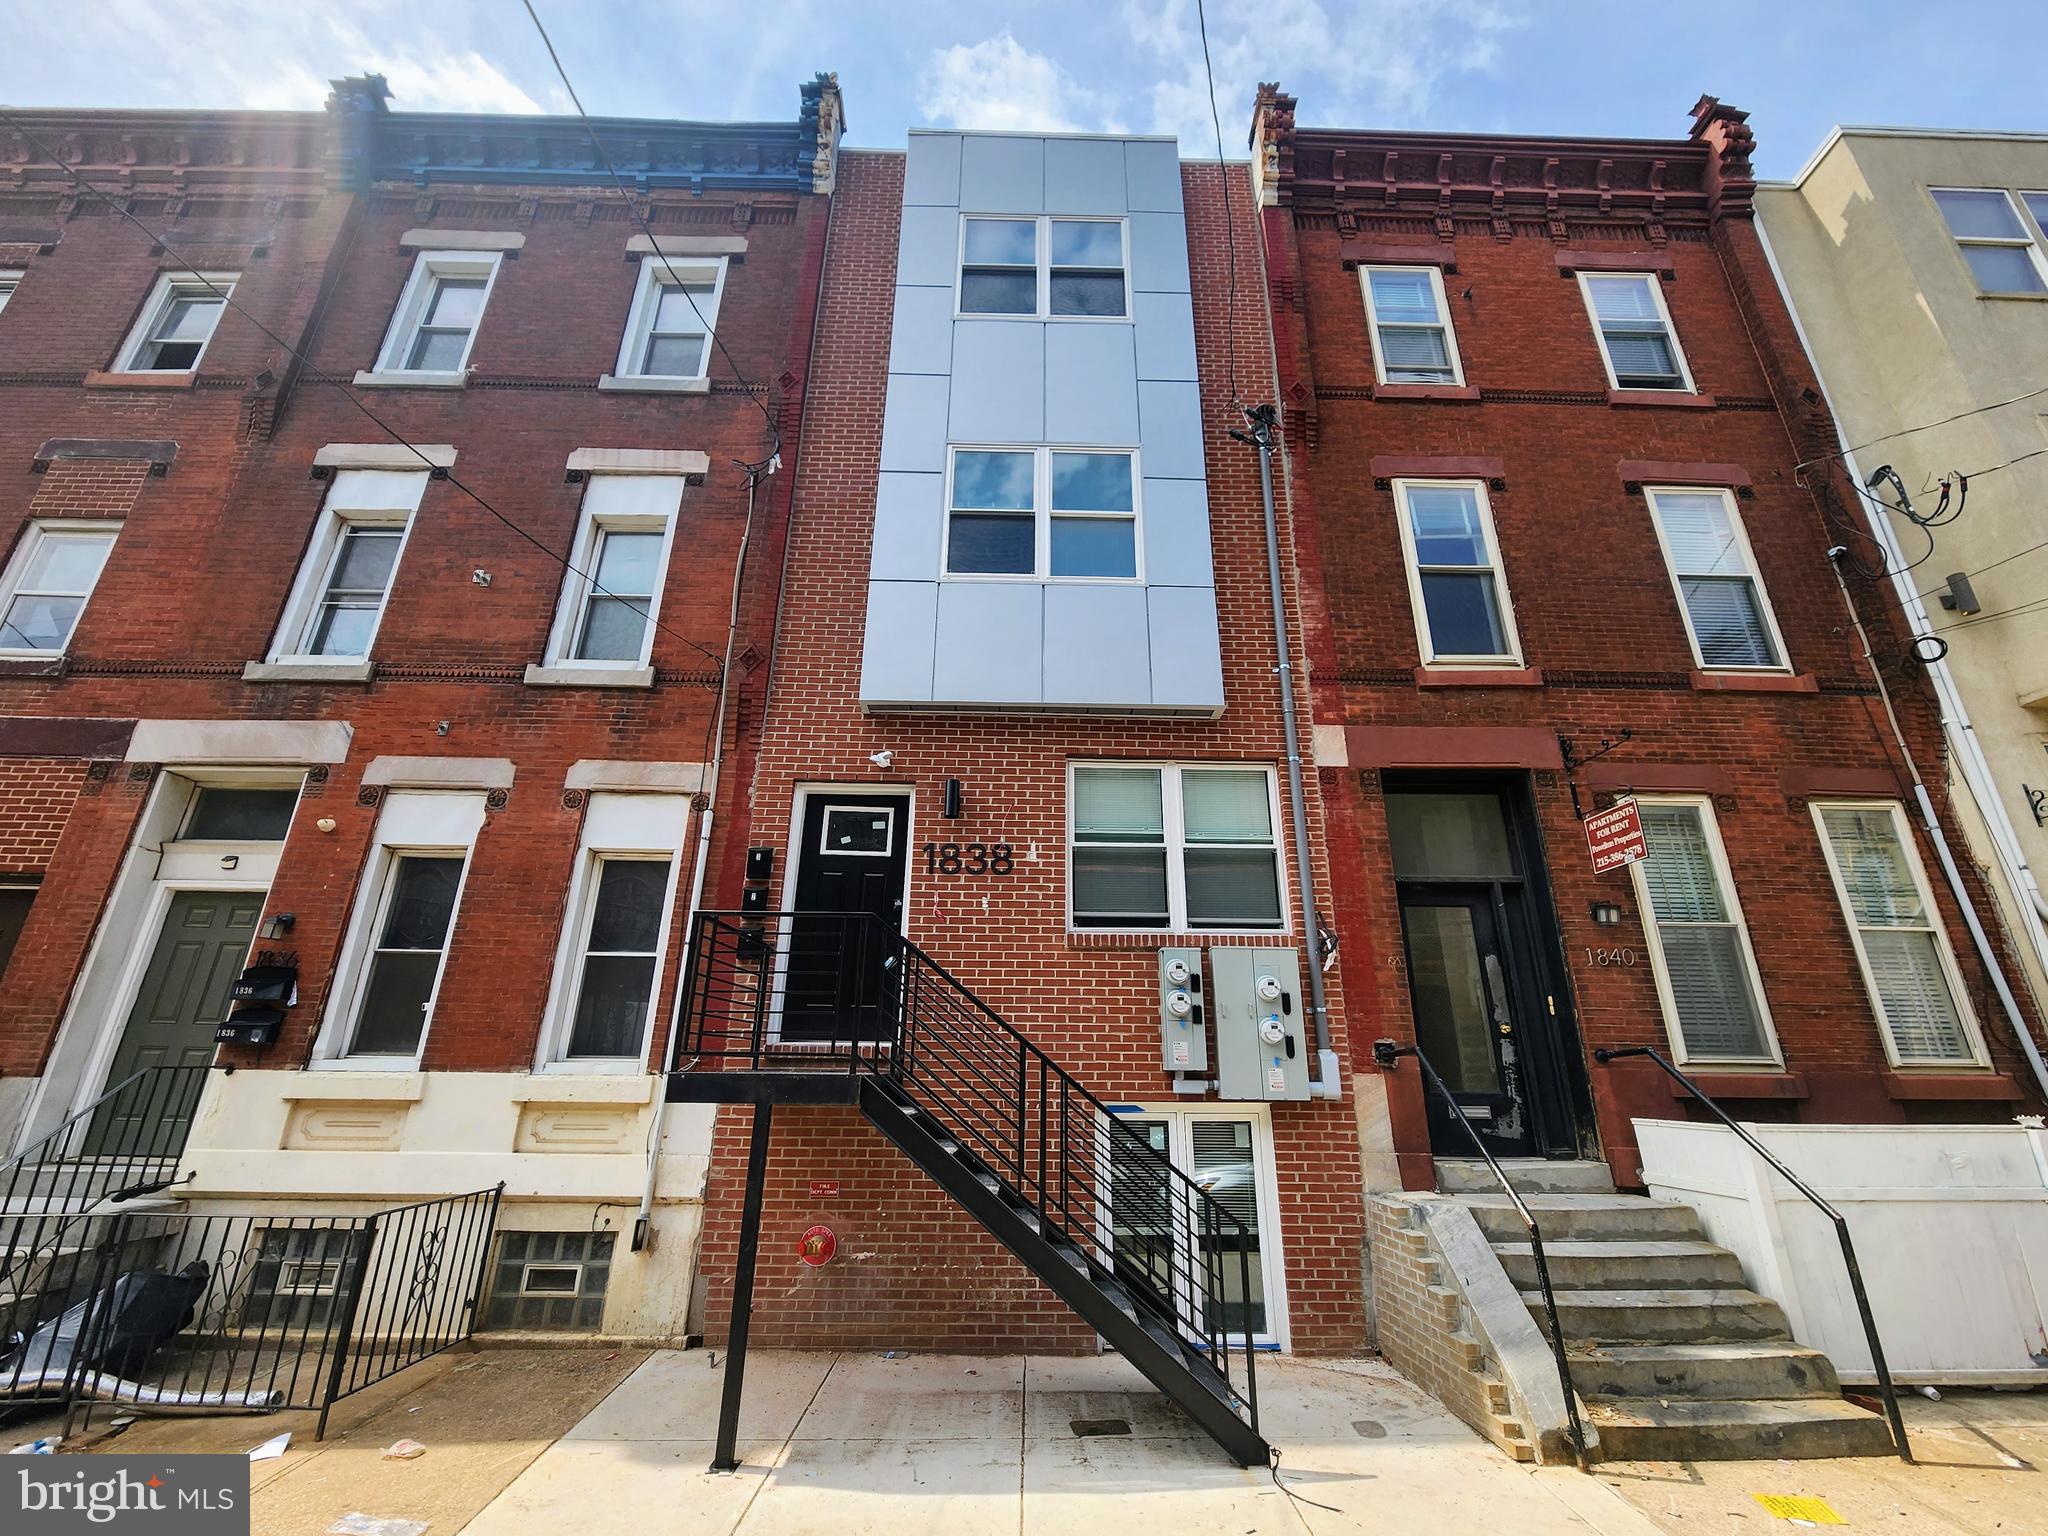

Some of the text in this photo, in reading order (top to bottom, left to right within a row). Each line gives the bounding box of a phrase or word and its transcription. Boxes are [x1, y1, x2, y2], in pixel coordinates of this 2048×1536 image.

[1589, 806, 1635, 831] APARTMENTS
[1596, 819, 1630, 839] FOR RENT
[1613, 830, 1642, 845] Properties
[922, 842, 1014, 876] 1838
[1585, 947, 1635, 966] 1840
[235, 986, 253, 995] 1836
[216, 1028, 235, 1037] 1836
